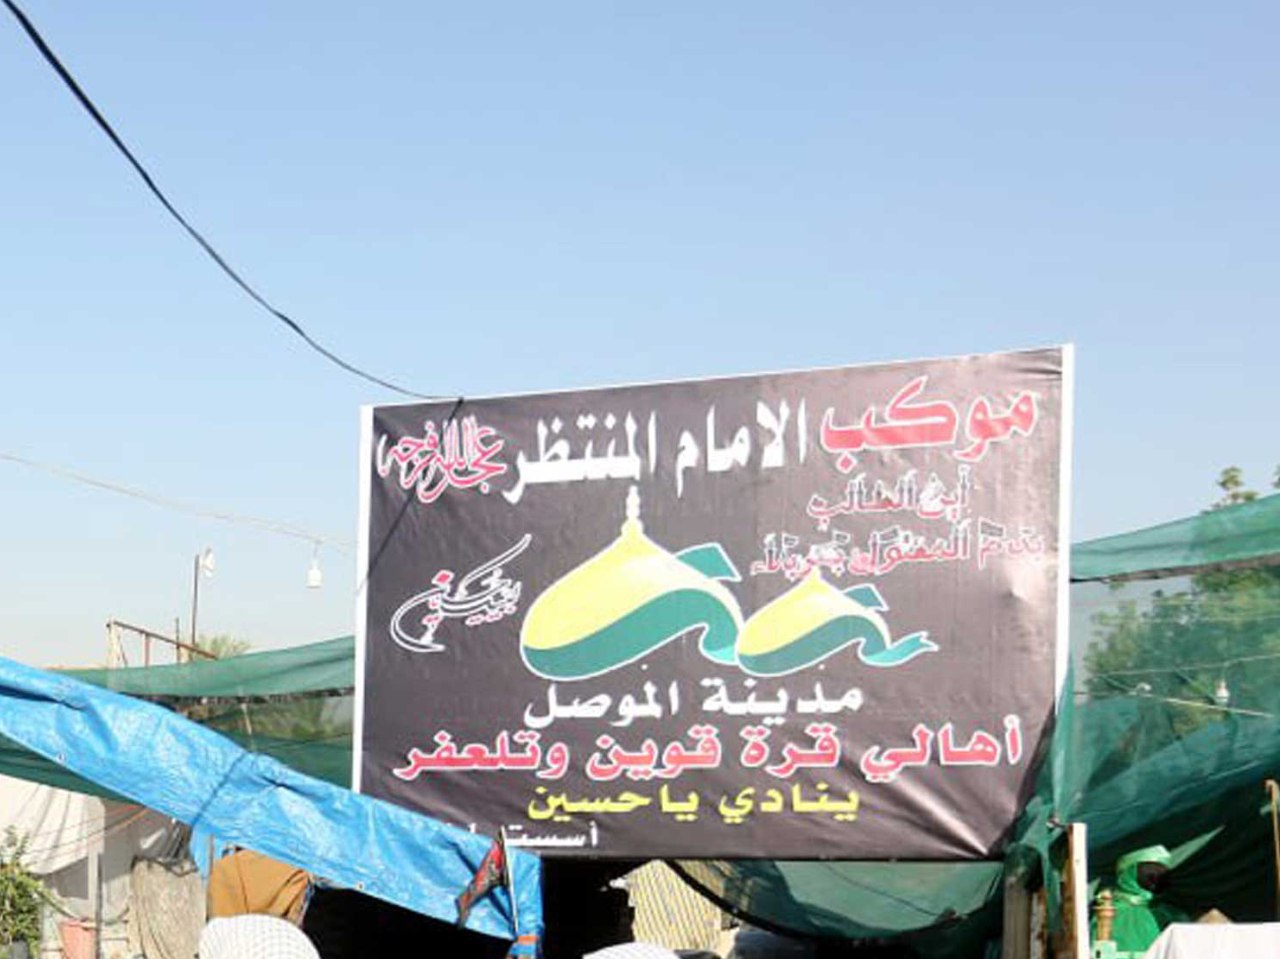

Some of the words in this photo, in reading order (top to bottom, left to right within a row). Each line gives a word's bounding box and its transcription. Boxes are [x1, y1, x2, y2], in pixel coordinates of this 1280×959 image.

[675, 398, 808, 500] الامام
[819, 375, 1042, 474] موكب
[502, 410, 658, 504] المنتظر
[523, 677, 679, 728] الموصل
[701, 675, 864, 725] مدينة
[393, 728, 570, 782] وتلعفر
[585, 724, 721, 780] قوين
[739, 722, 841, 778] قرة
[860, 716, 1022, 784] أهالي
[718, 781, 860, 824] ينادي
